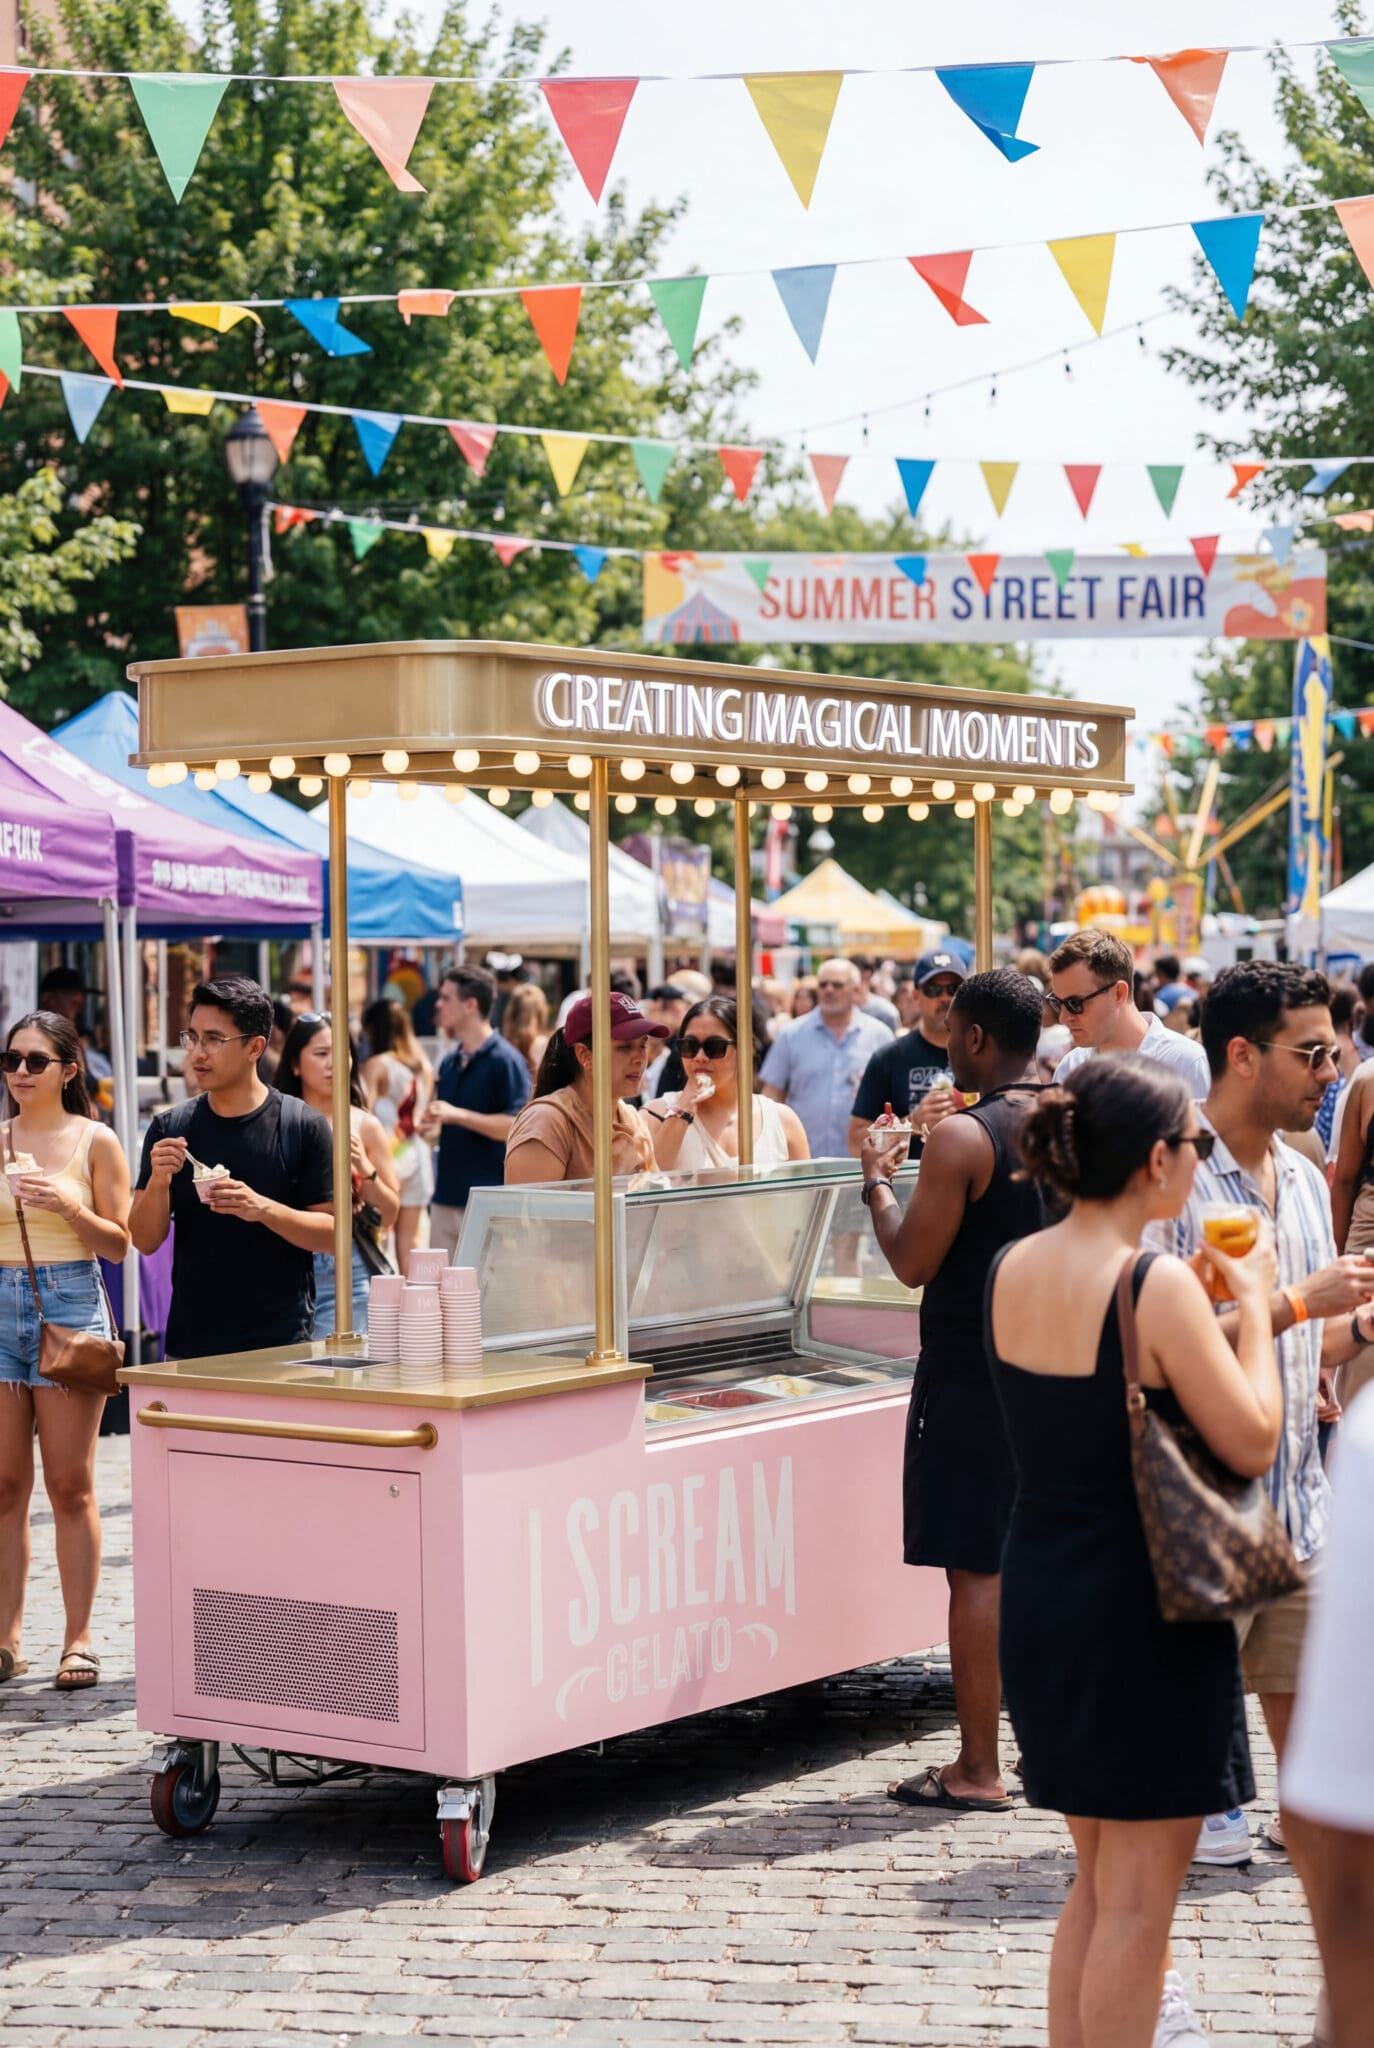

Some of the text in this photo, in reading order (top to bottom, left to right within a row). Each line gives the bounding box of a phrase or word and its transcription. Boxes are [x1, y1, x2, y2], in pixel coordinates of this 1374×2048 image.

[758, 574, 1207, 621] SUMMER STREET FAIR
[540, 671, 1100, 769] CREATING MAGICAL MOMENTS
[527, 1455, 796, 1688] I SCREAM
[606, 1615, 732, 1704] GELATO
